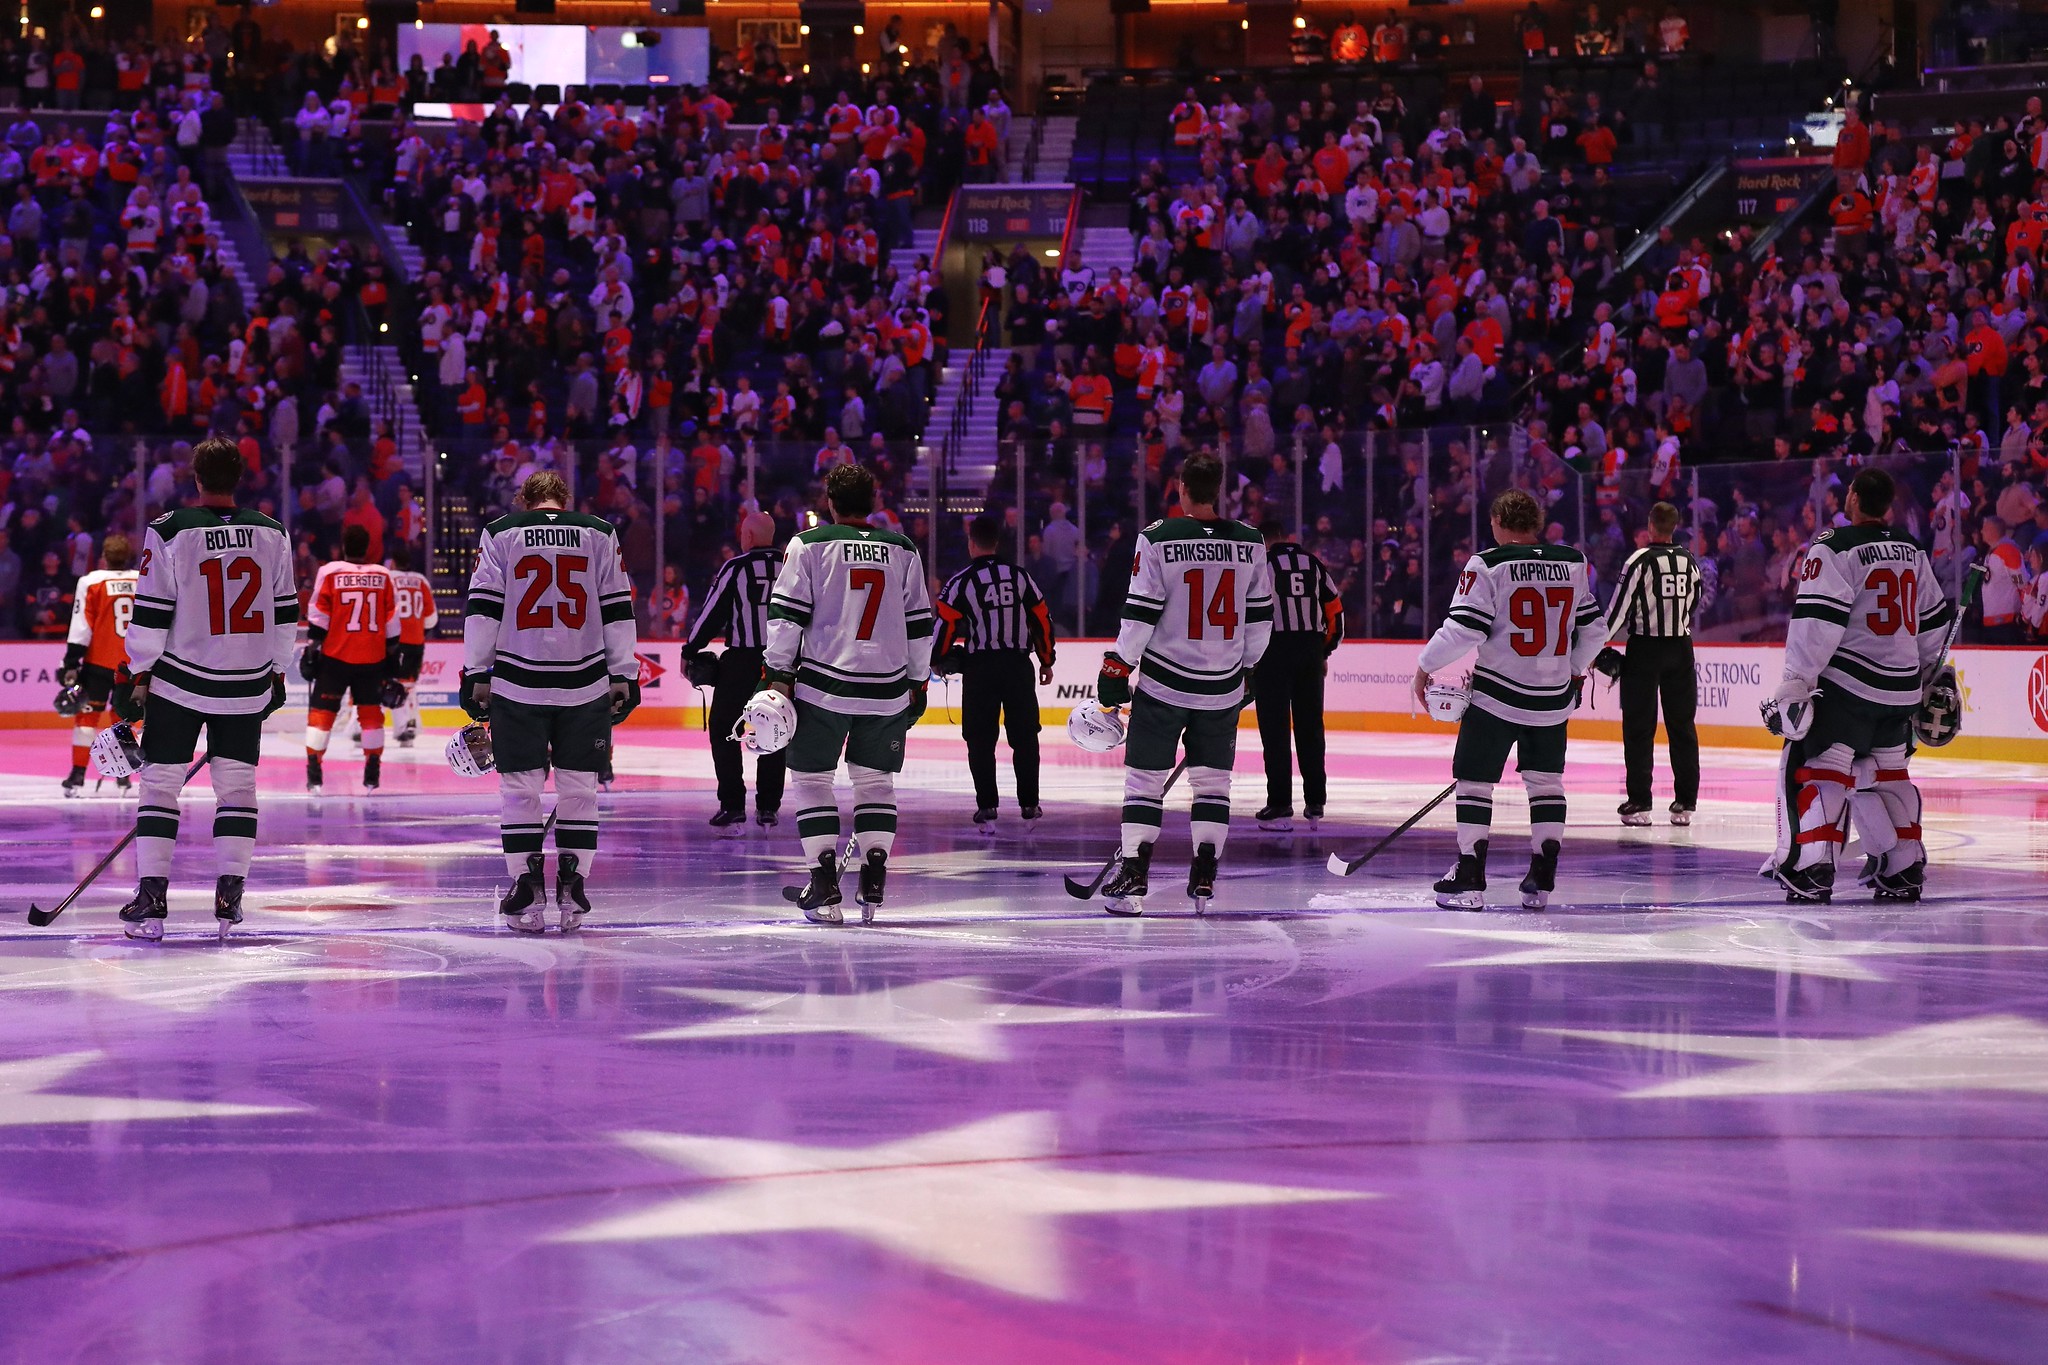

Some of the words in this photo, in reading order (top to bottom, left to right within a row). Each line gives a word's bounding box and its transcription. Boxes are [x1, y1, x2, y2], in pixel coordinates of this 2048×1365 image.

[1738, 199, 1757, 215] 117
[968, 219, 988, 233] 118
[205, 528, 254, 551] BOLDY
[524, 528, 581, 548] BRODIN
[843, 543, 890, 564] FABER
[1163, 543, 1232, 563] ERIKSSON
[1237, 545, 1254, 564] EK
[336, 575, 384, 587] FOERSTER
[1509, 563, 1570, 581] KAPRIZOV
[1801, 557, 1823, 582] 30
[110, 582, 134, 594] YORK
[513, 554, 589, 631] 25
[754, 579, 775, 604] 7
[984, 581, 1014, 607] 46
[1290, 572, 1305, 596] 6
[1458, 571, 1478, 596] 97
[1661, 574, 1688, 597] 68
[199, 556, 265, 636] 12
[399, 589, 425, 620] 80
[849, 568, 886, 641] 7
[1183, 568, 1239, 640] 14
[1865, 567, 1918, 637] 30
[340, 591, 379, 632] 71
[1509, 586, 1575, 657] 97
[2, 668, 32, 683] OF
[37, 668, 58, 683] A
[1705, 662, 1761, 685] STRONG
[1056, 684, 1097, 699] NHL
